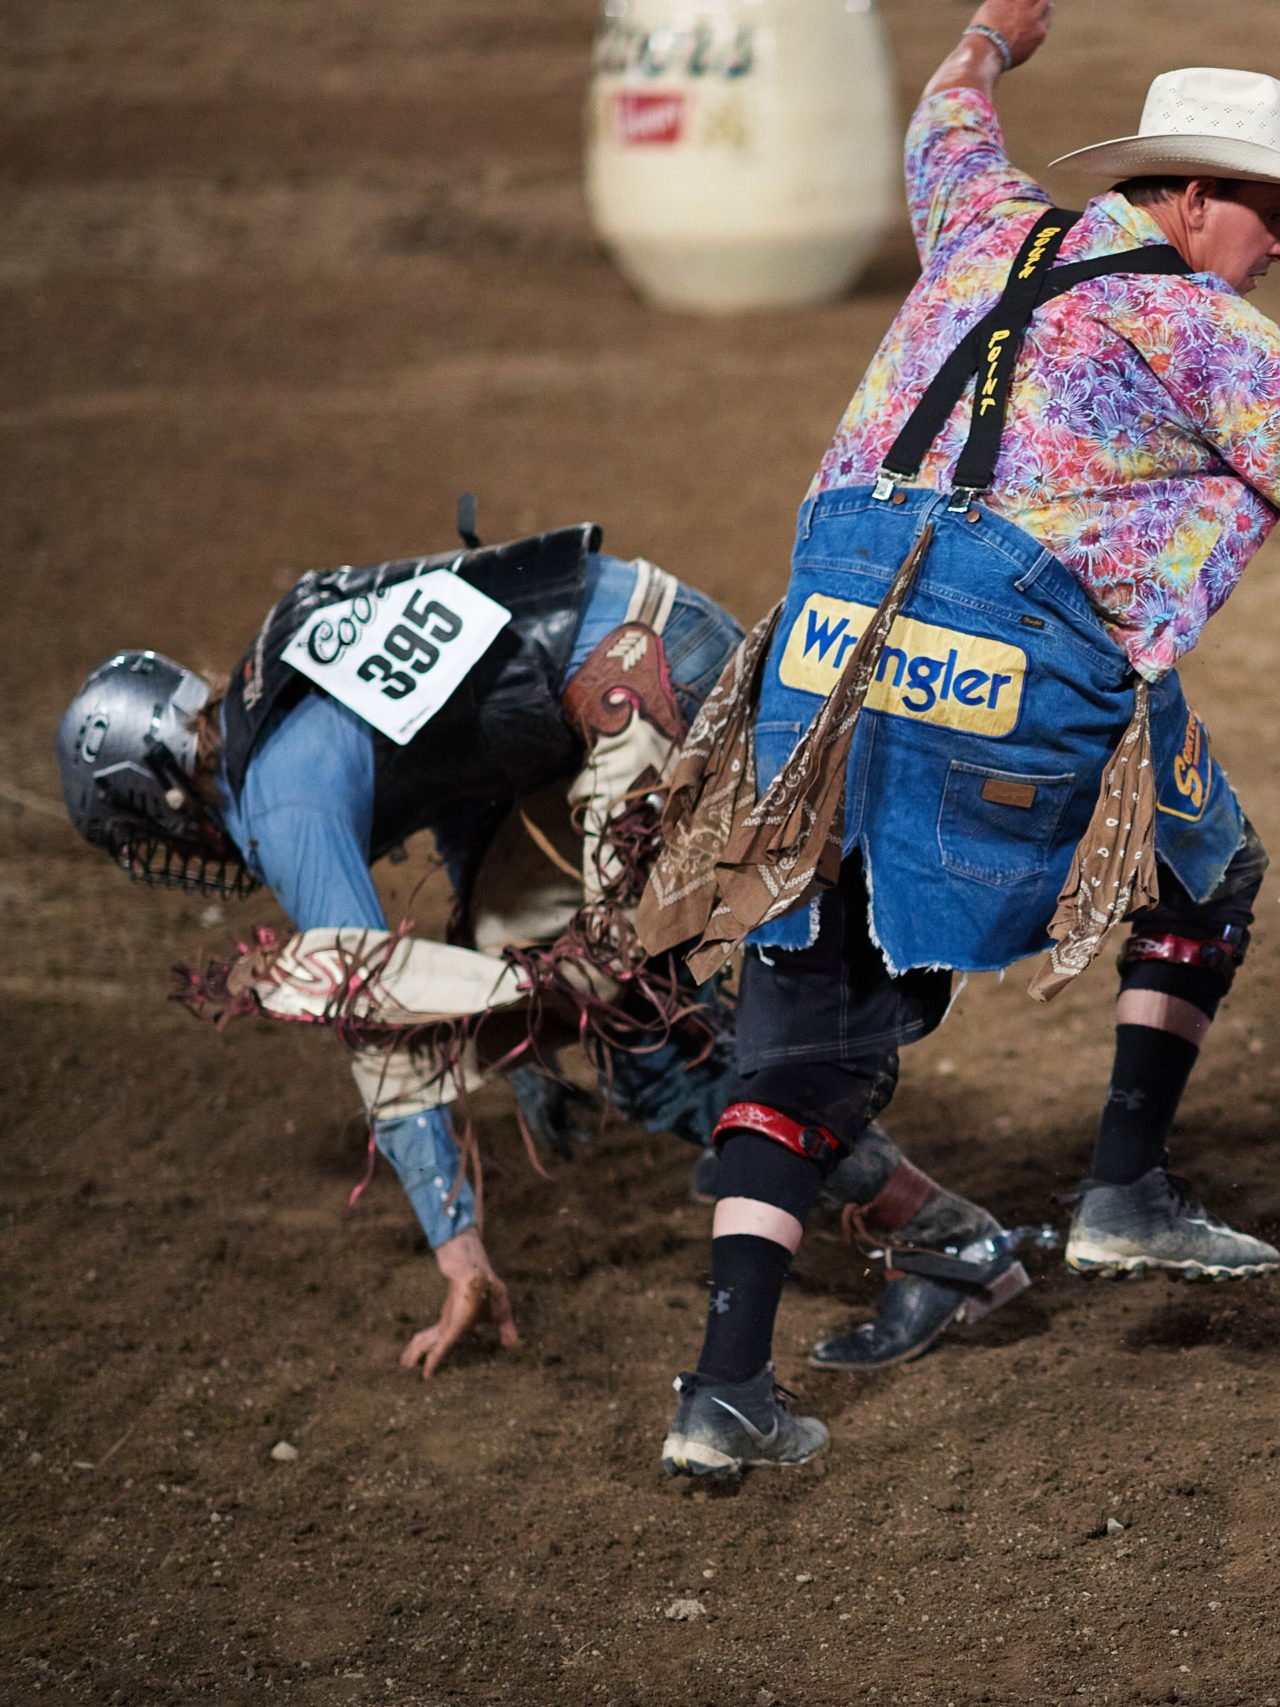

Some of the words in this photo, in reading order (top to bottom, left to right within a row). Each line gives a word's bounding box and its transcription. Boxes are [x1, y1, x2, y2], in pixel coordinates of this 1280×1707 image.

[1018, 227, 1061, 279] SOUTH
[980, 329, 1010, 416] POINT
[306, 585, 390, 665] Coo
[357, 588, 463, 700] 395
[802, 609, 1012, 713] Wrngler
